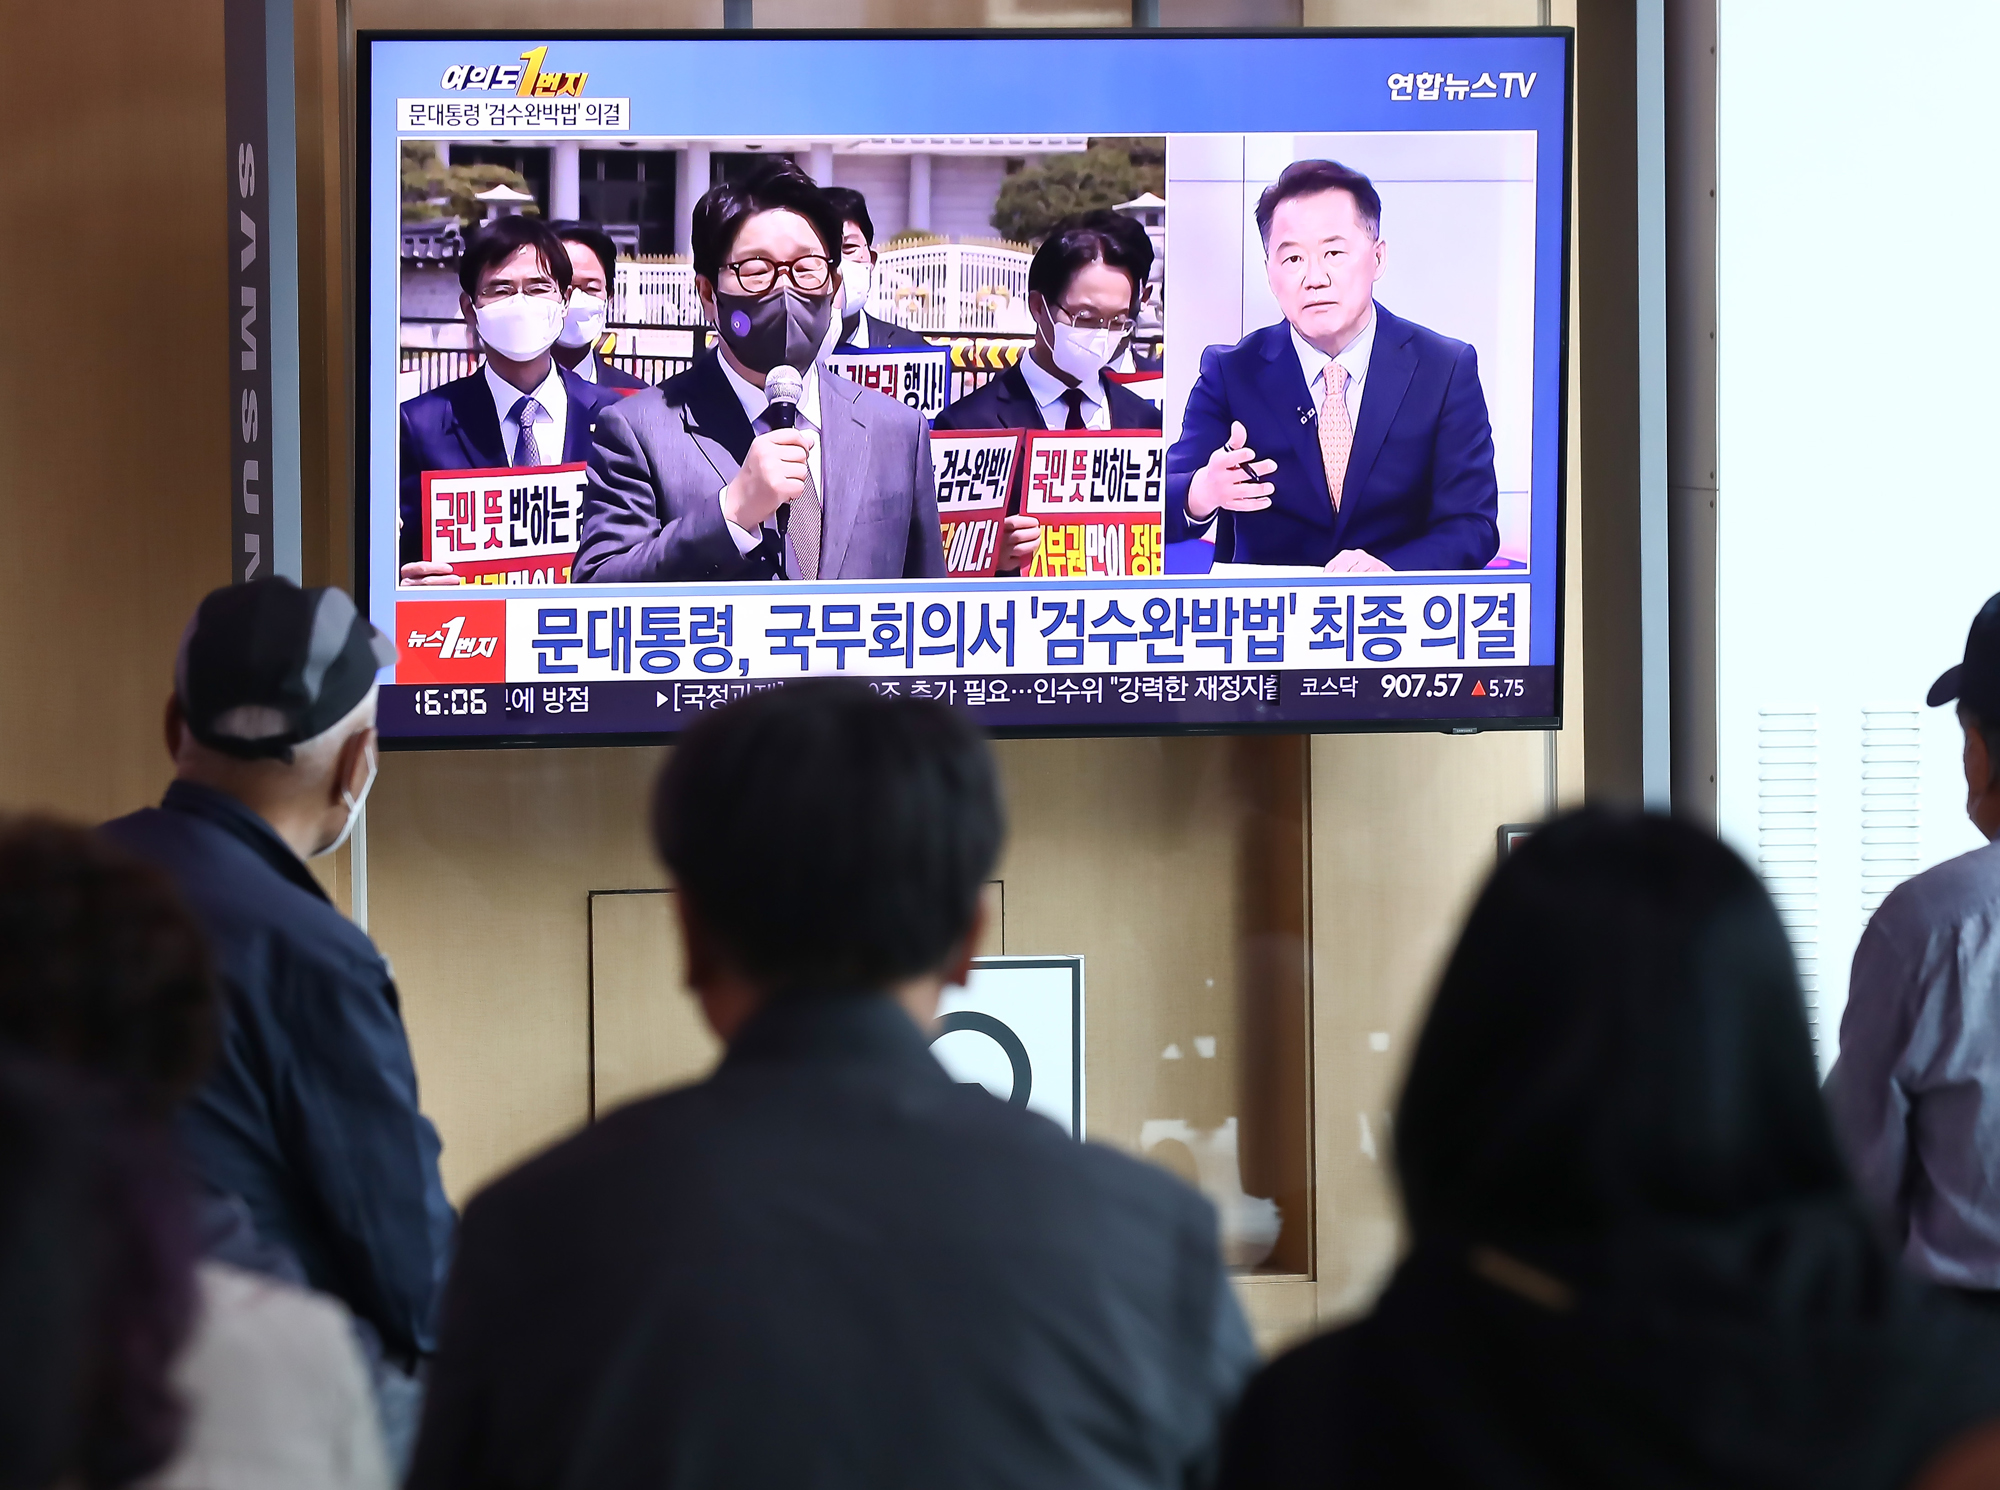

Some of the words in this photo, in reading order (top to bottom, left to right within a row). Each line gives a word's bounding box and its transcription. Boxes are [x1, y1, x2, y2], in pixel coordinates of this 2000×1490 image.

[1387, 72, 1537, 101] 연합뉴스TV
[408, 103, 480, 127] 문대통령
[485, 102, 581, 127] '검수완박법'
[585, 102, 620, 126] 의결
[238, 142, 261, 582] SAMSUN
[1032, 449, 1067, 503] 국민
[1069, 449, 1088, 503] 뜻
[1090, 448, 1141, 503] 반하는
[436, 490, 476, 552] 국민
[483, 489, 503, 550] 뜻
[509, 485, 570, 548] 반하는
[407, 616, 498, 659] 뉴스1번지
[532, 604, 749, 677] 문대통령,
[765, 600, 1015, 671] 국무회의서
[1030, 592, 1297, 666] '검수완박법'
[1309, 594, 1407, 662] 최종
[1420, 592, 1516, 660] 의결
[542, 685, 590, 713] 방점
[1110, 674, 1189, 704] "강력한
[1300, 675, 1359, 699] 코스닥
[1380, 673, 1464, 699] 907.57
[1488, 678, 1525, 698] 5.75
[415, 688, 487, 716] 16:06
